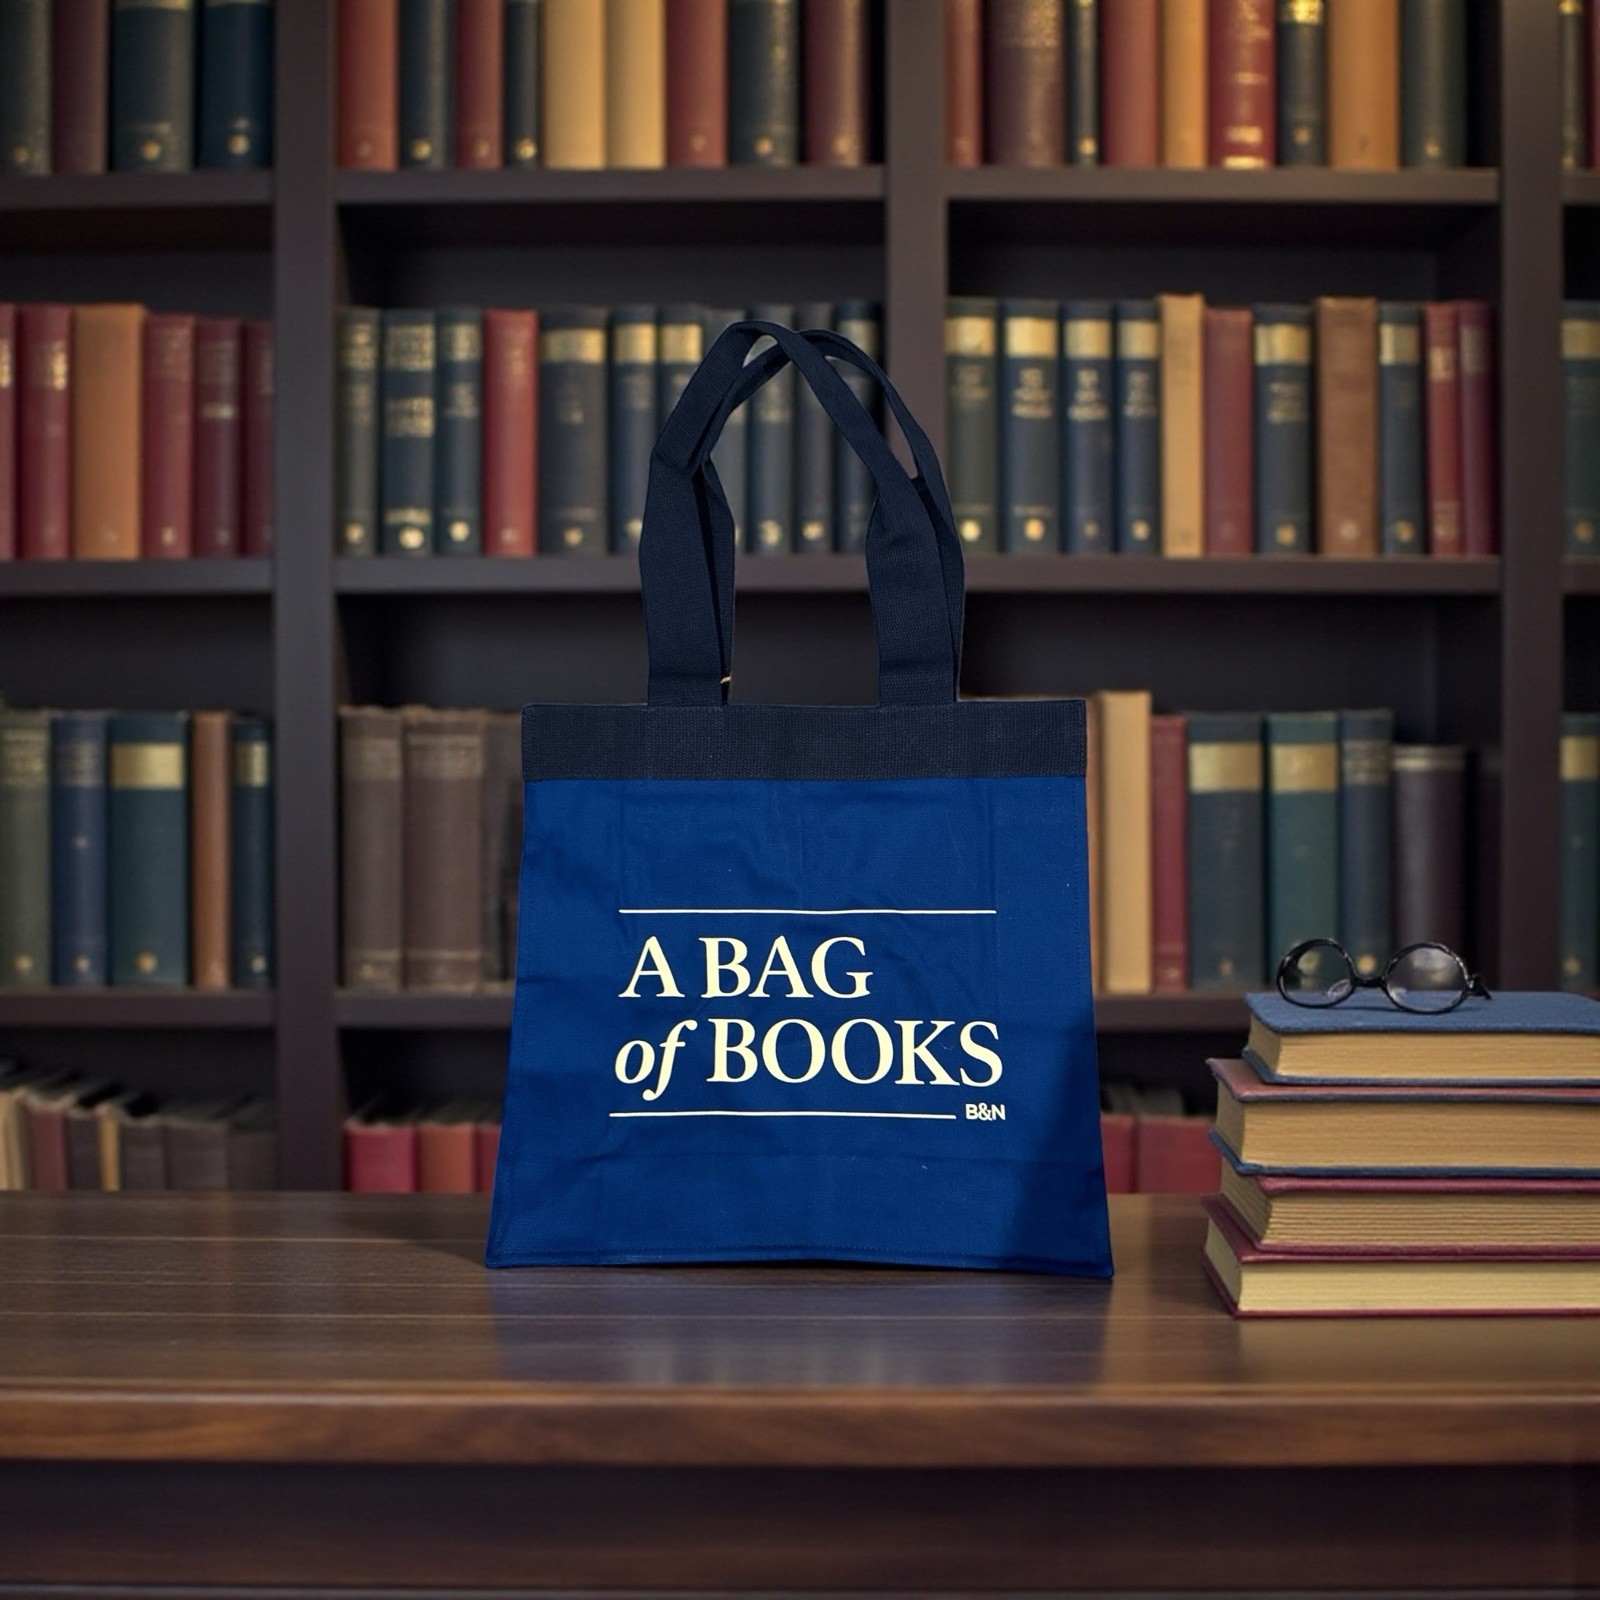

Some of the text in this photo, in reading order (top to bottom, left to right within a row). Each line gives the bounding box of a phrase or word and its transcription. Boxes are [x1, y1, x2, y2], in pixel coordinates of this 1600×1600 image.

[618, 935, 874, 999] A BAG
[614, 1018, 1003, 1101] of BOOKS
[965, 1103, 1006, 1121] B&N
